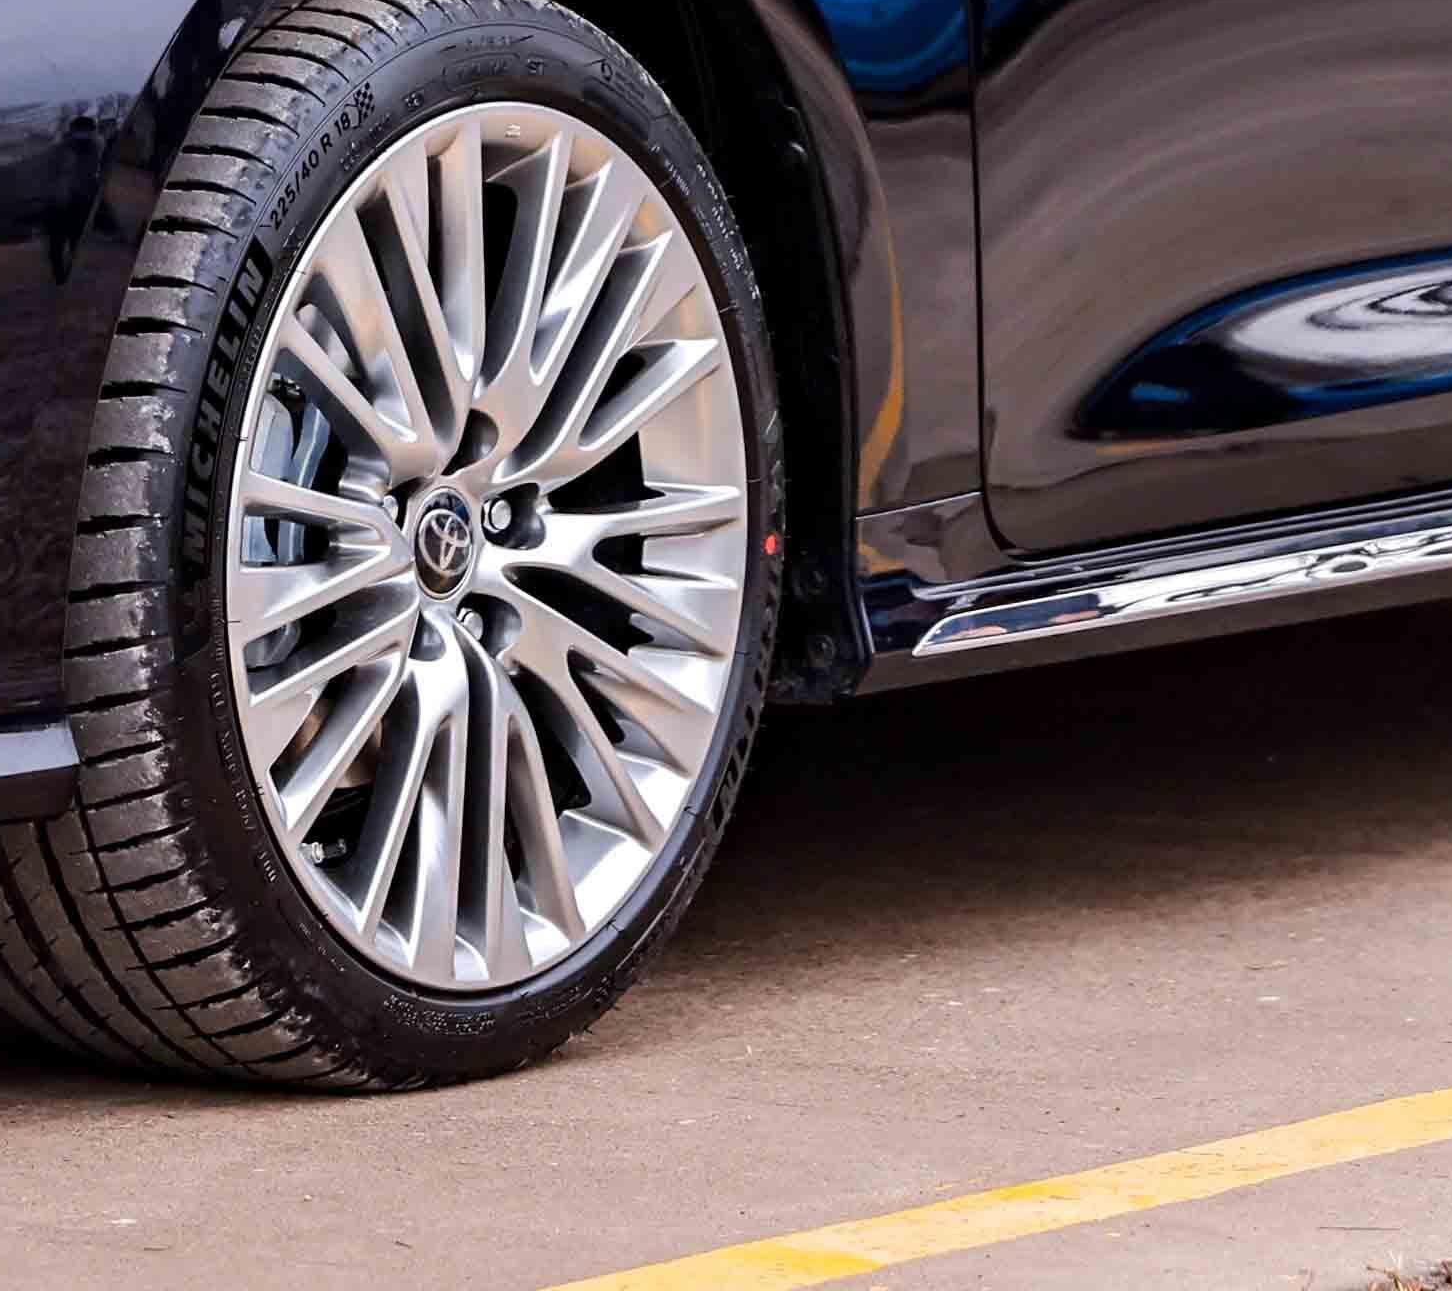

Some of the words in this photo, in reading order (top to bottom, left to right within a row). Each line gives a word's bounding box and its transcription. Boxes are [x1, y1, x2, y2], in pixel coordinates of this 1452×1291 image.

[270, 149, 320, 231] 225/40
[320, 133, 334, 155] R
[334, 112, 351, 137] 18
[183, 256, 265, 562] MICHELIN
